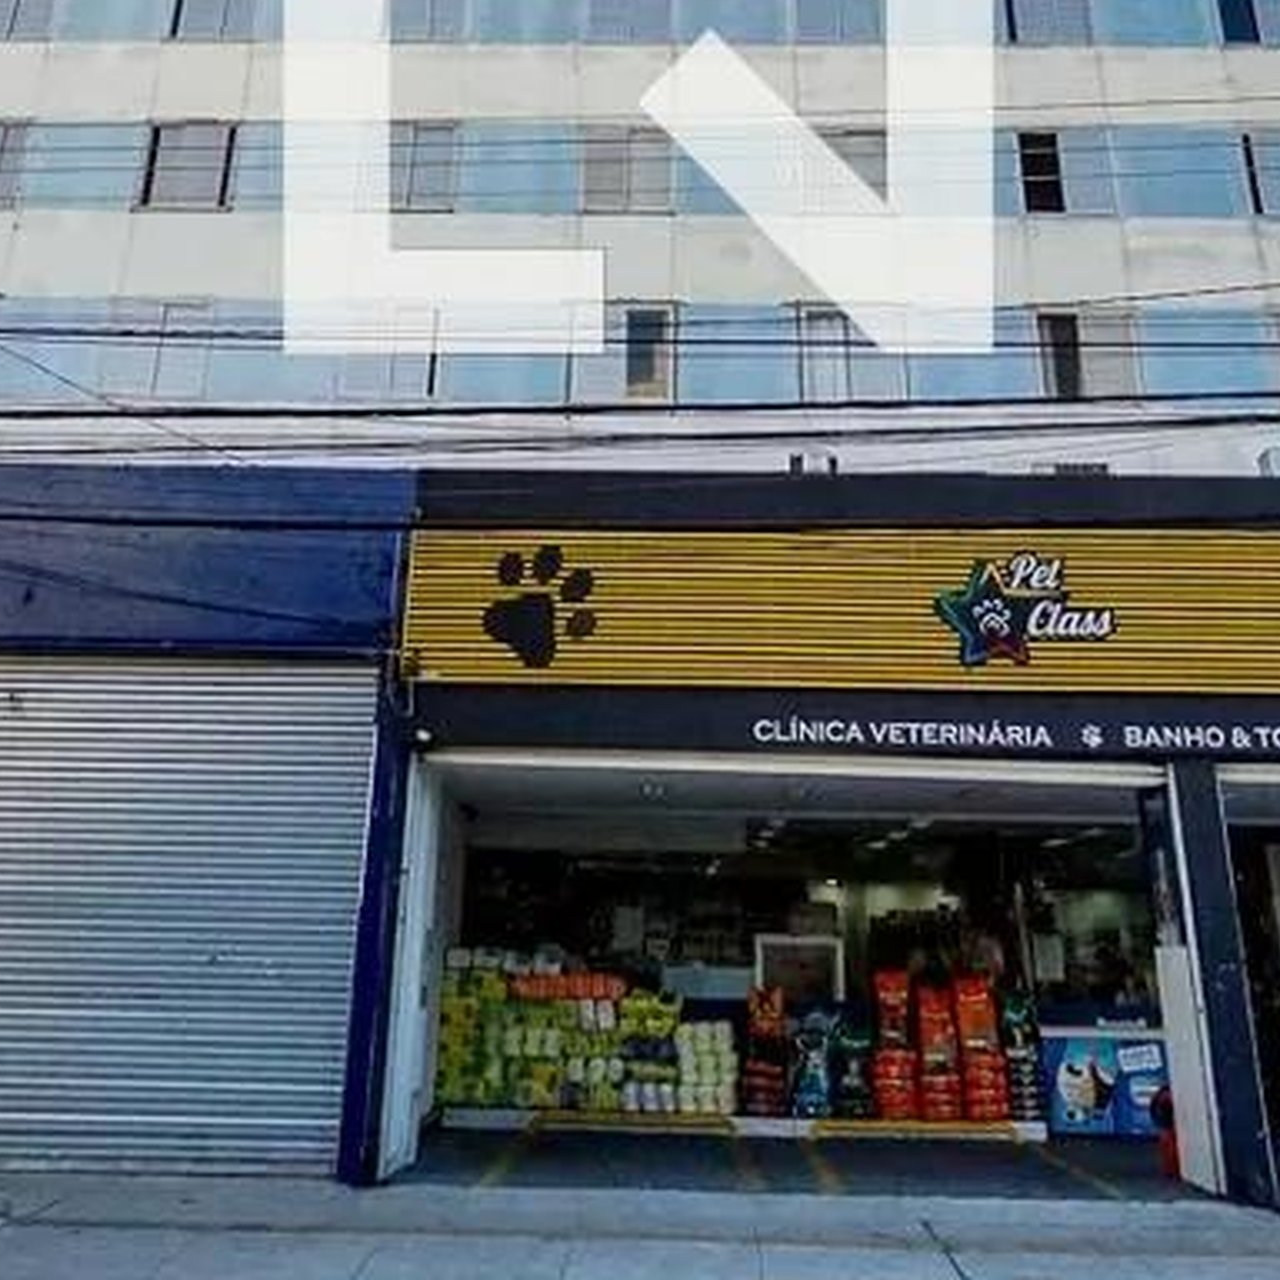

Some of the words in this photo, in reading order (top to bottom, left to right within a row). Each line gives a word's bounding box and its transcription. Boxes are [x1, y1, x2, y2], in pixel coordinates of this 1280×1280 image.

[1026, 600, 1112, 637] Class
[752, 715, 865, 743] CLÍNICA
[869, 719, 1053, 748] VETERINÁRIA
[1123, 724, 1225, 749] BANHO
[1231, 725, 1252, 749] &
